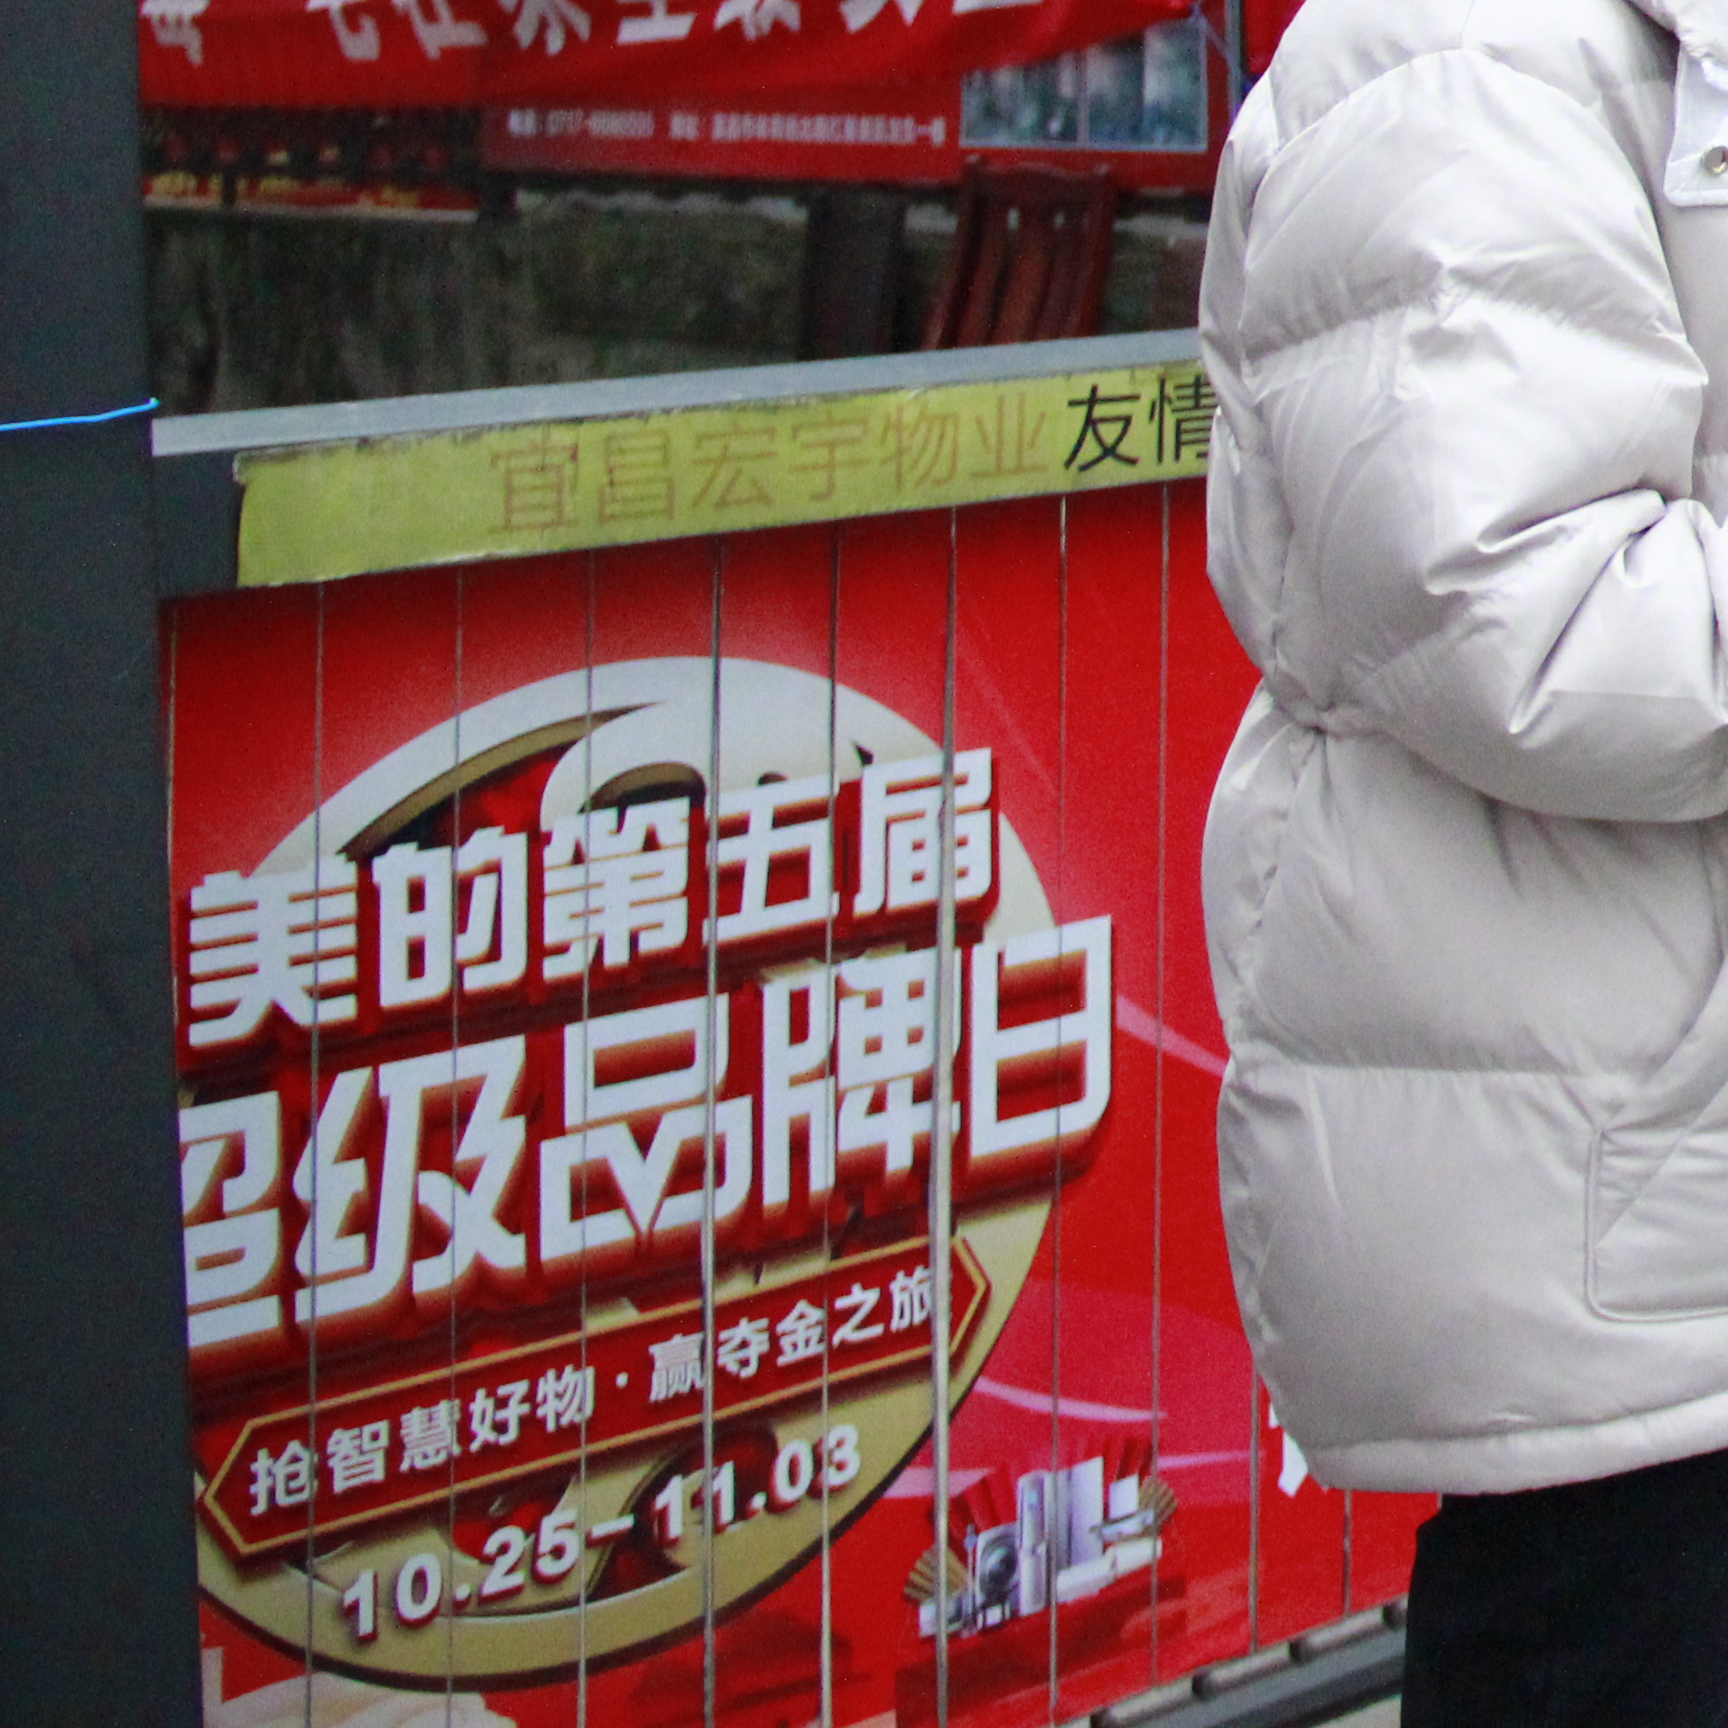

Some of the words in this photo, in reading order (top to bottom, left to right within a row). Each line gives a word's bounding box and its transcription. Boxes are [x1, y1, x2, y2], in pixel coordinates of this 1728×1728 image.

[188, 748, 994, 1048] 美的第五届
[342, 1425, 862, 1639] 10.25-11.03
